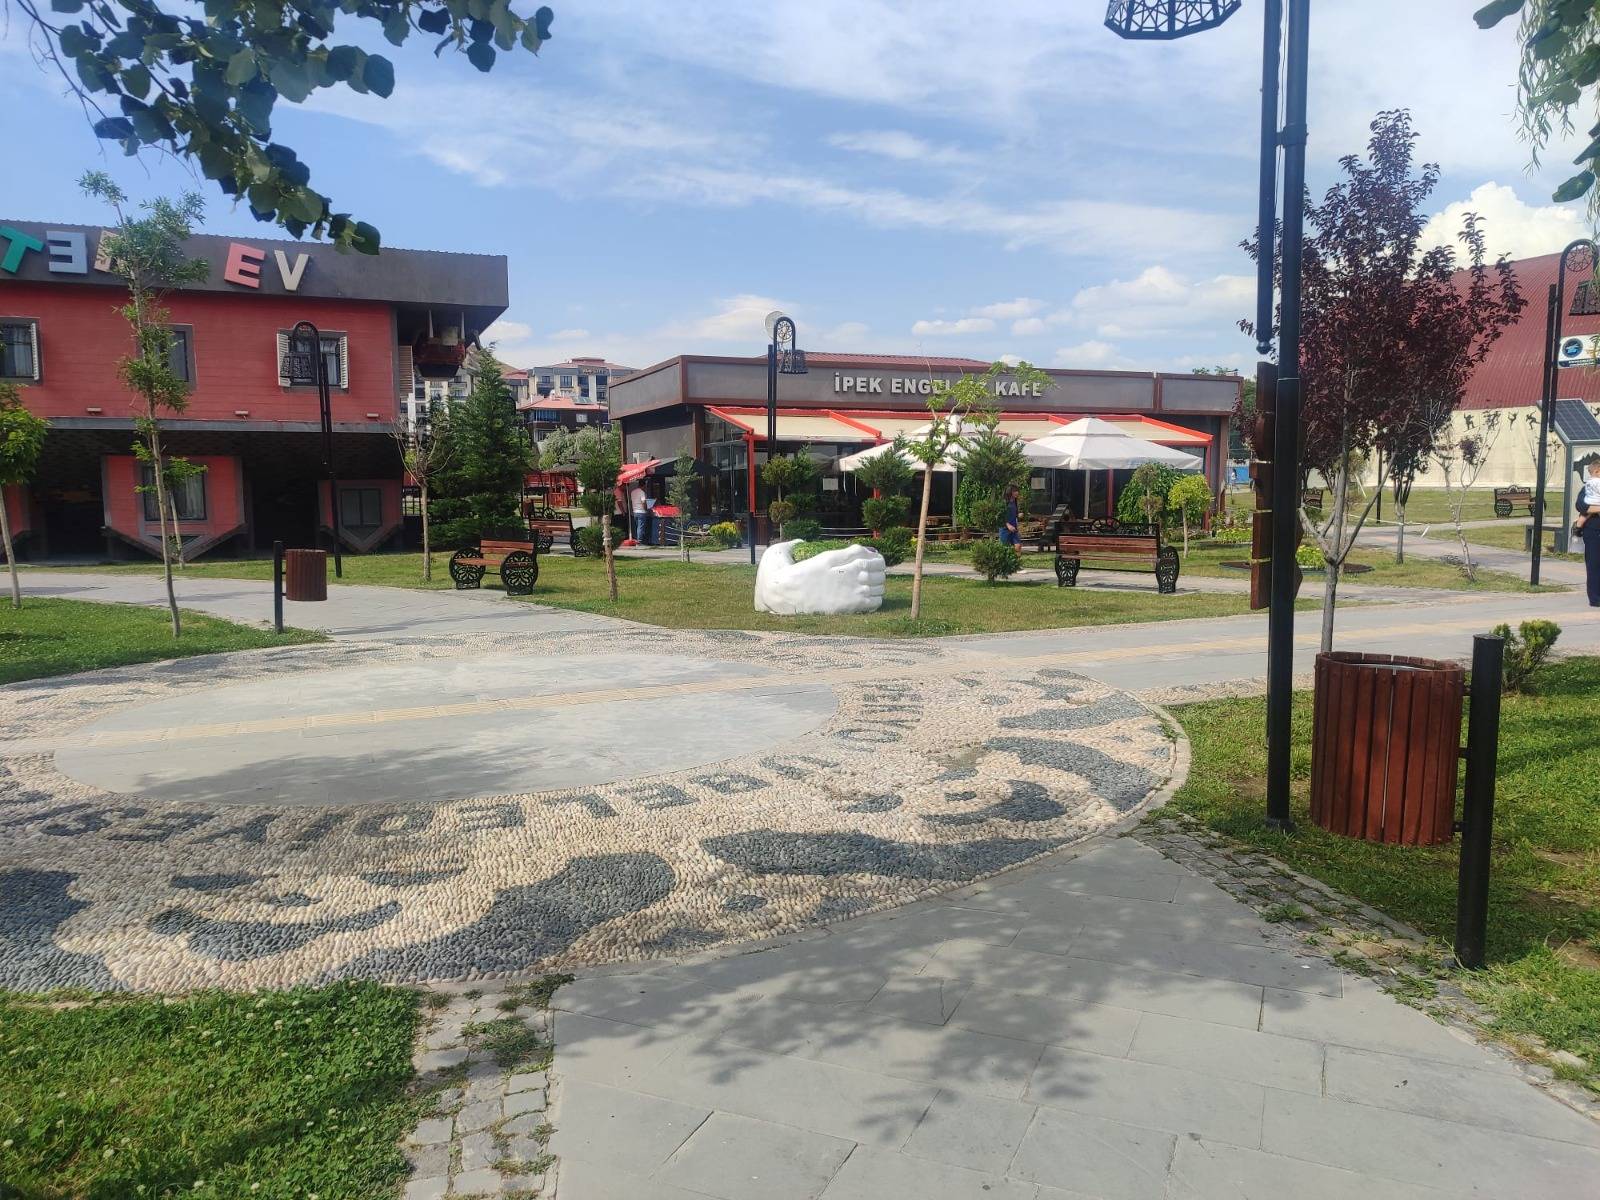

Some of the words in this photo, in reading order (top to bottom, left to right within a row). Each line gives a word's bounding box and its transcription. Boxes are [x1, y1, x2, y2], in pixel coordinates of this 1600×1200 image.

[223, 241, 310, 292] EV
[834, 372, 883, 393] İPEK
[891, 377, 988, 396] ENGEL
[995, 380, 1042, 397] KAFE
